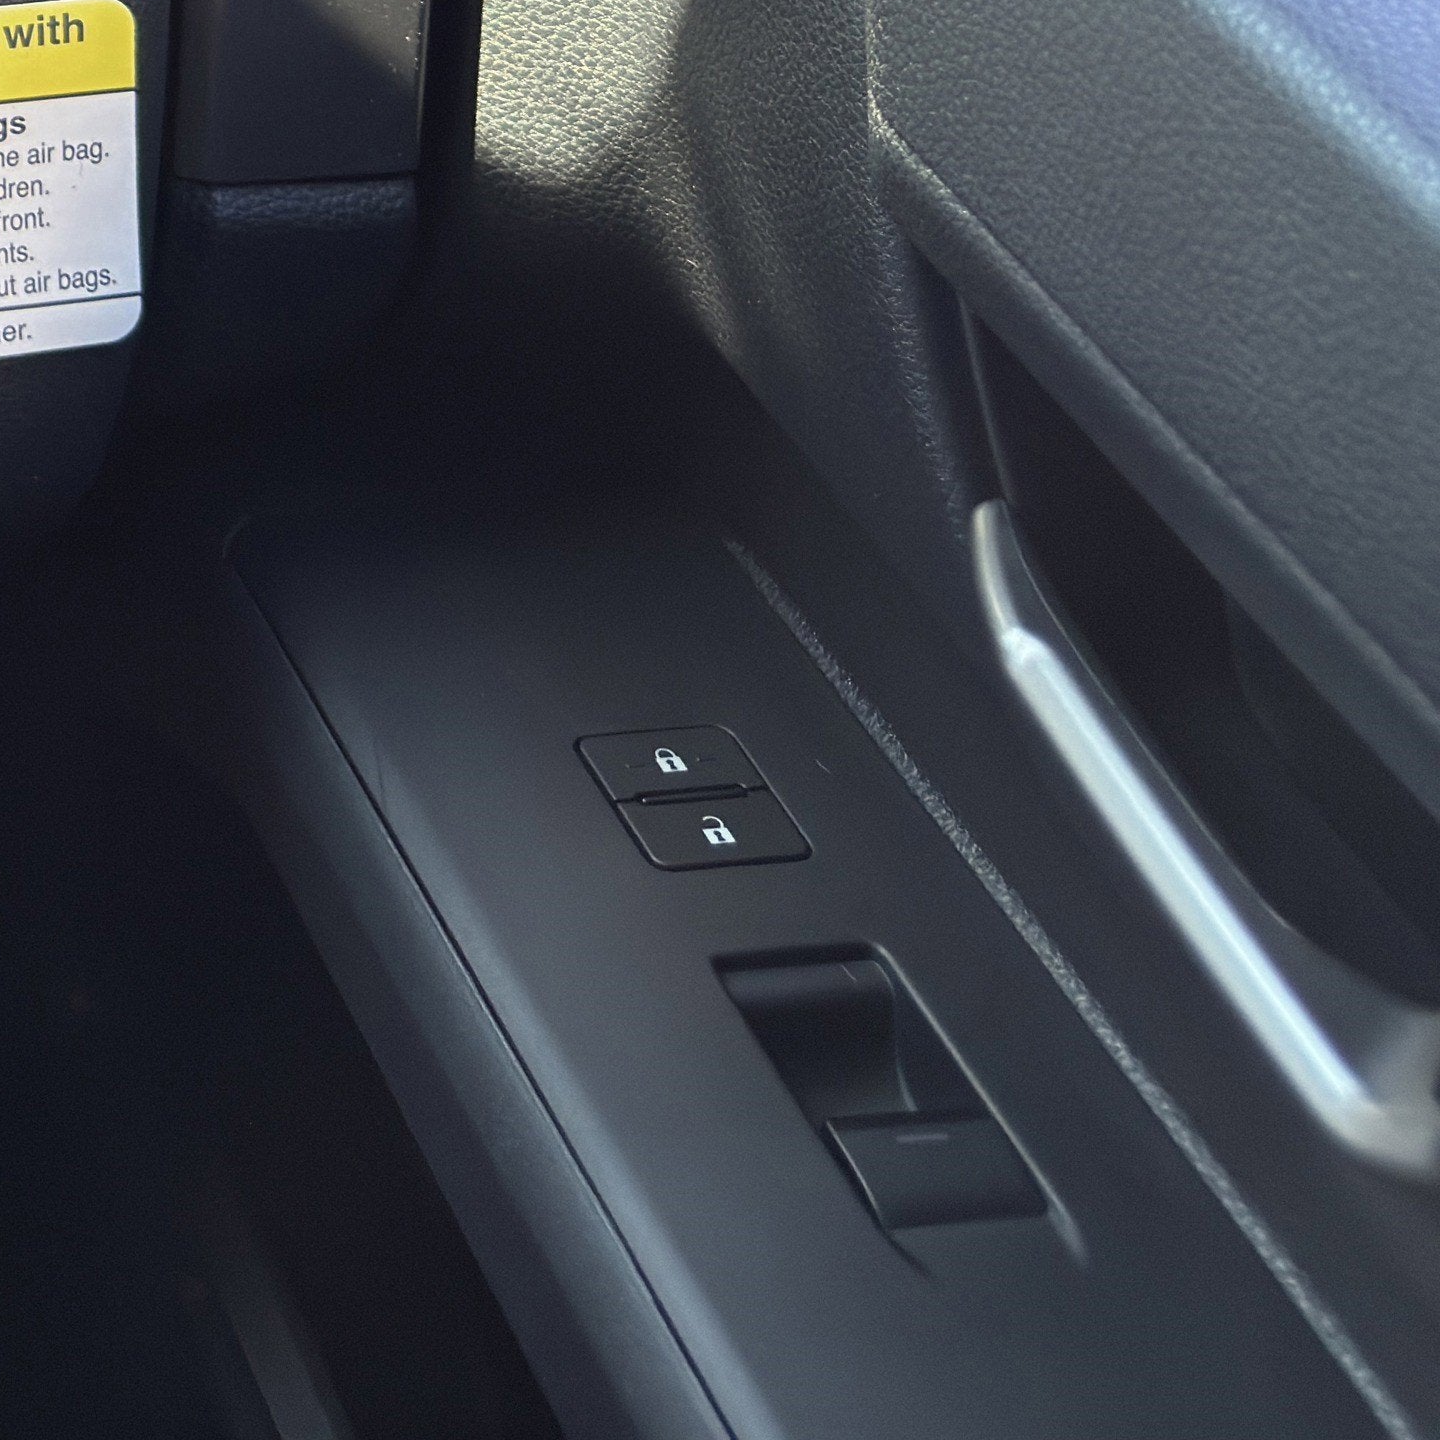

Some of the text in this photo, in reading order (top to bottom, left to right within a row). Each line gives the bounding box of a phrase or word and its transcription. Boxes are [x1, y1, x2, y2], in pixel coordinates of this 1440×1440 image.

[3, 12, 85, 50] with
[27, 142, 55, 165] air
[62, 139, 110, 165] bag.
[24, 270, 50, 296] air
[58, 266, 118, 294] bags.
